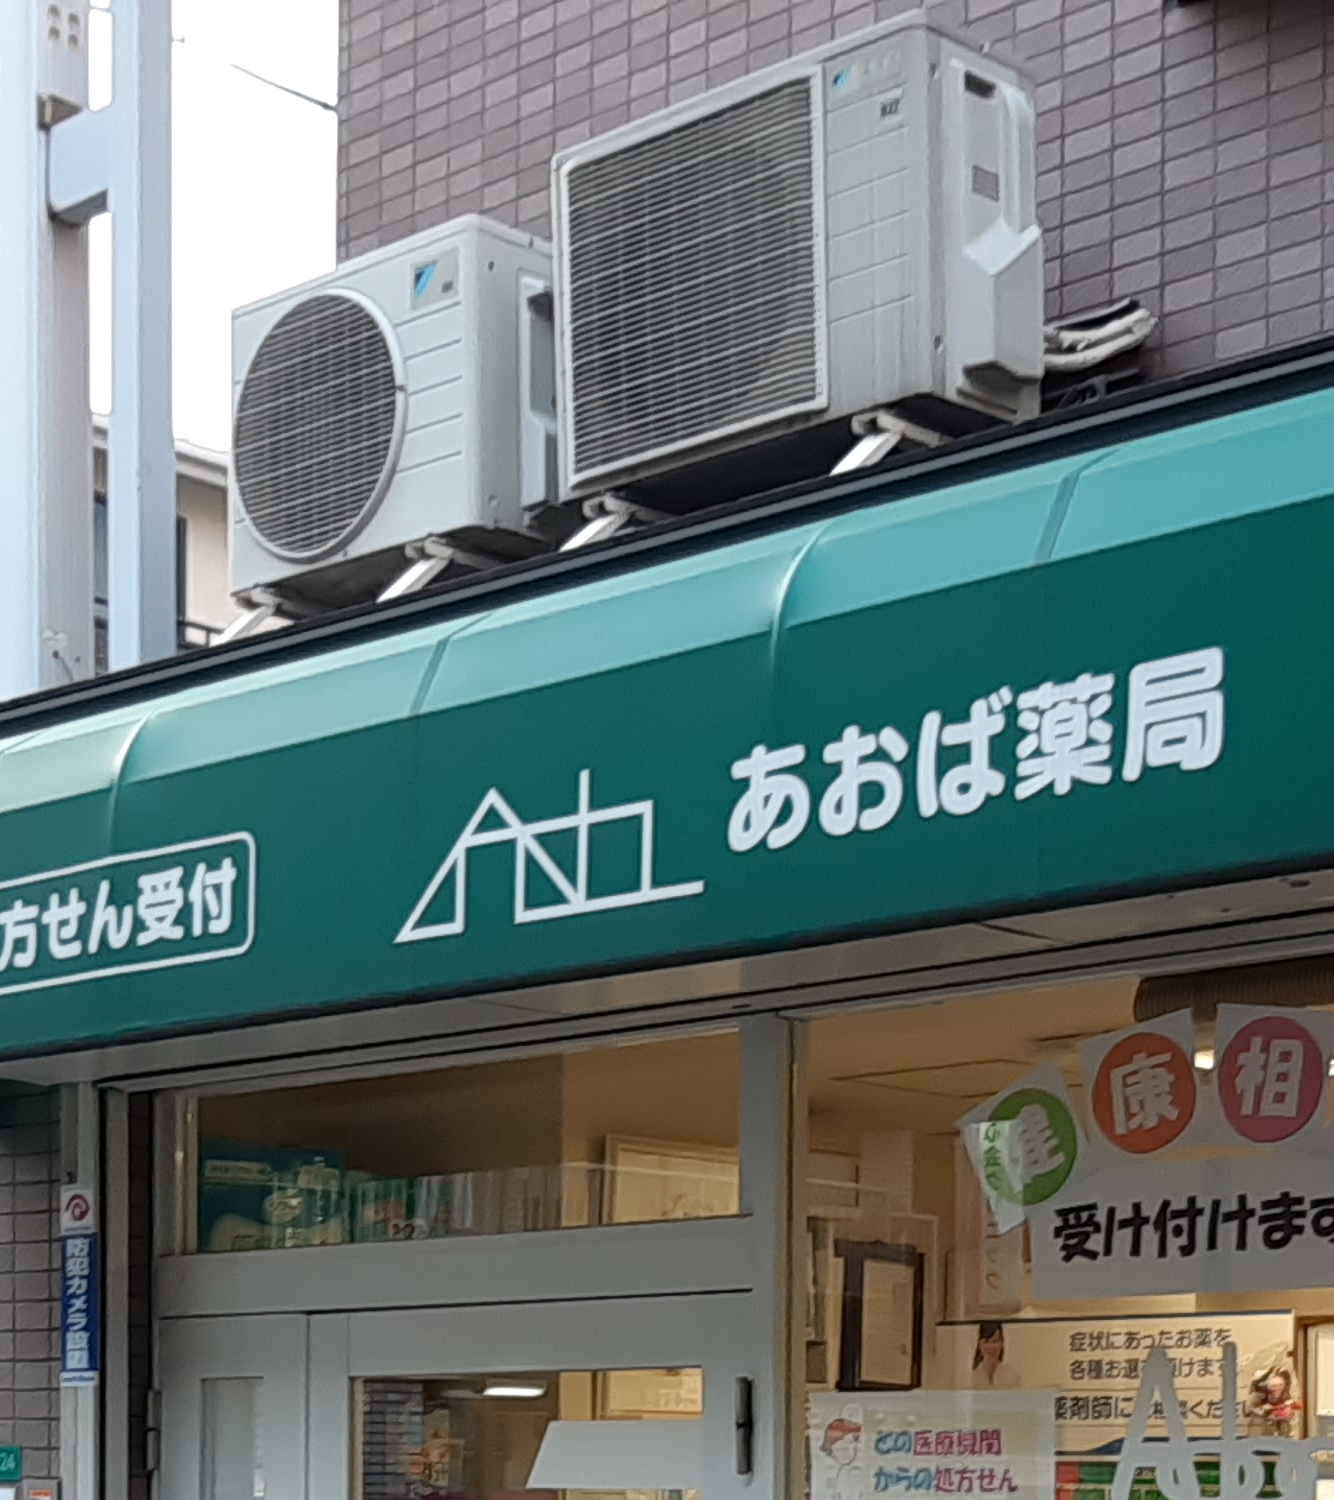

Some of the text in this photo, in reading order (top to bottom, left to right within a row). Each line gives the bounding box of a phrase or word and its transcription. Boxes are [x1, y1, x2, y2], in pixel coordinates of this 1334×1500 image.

[727, 647, 1226, 853] あおば薬局
[873, 1466, 1020, 1494] からの処方せん
